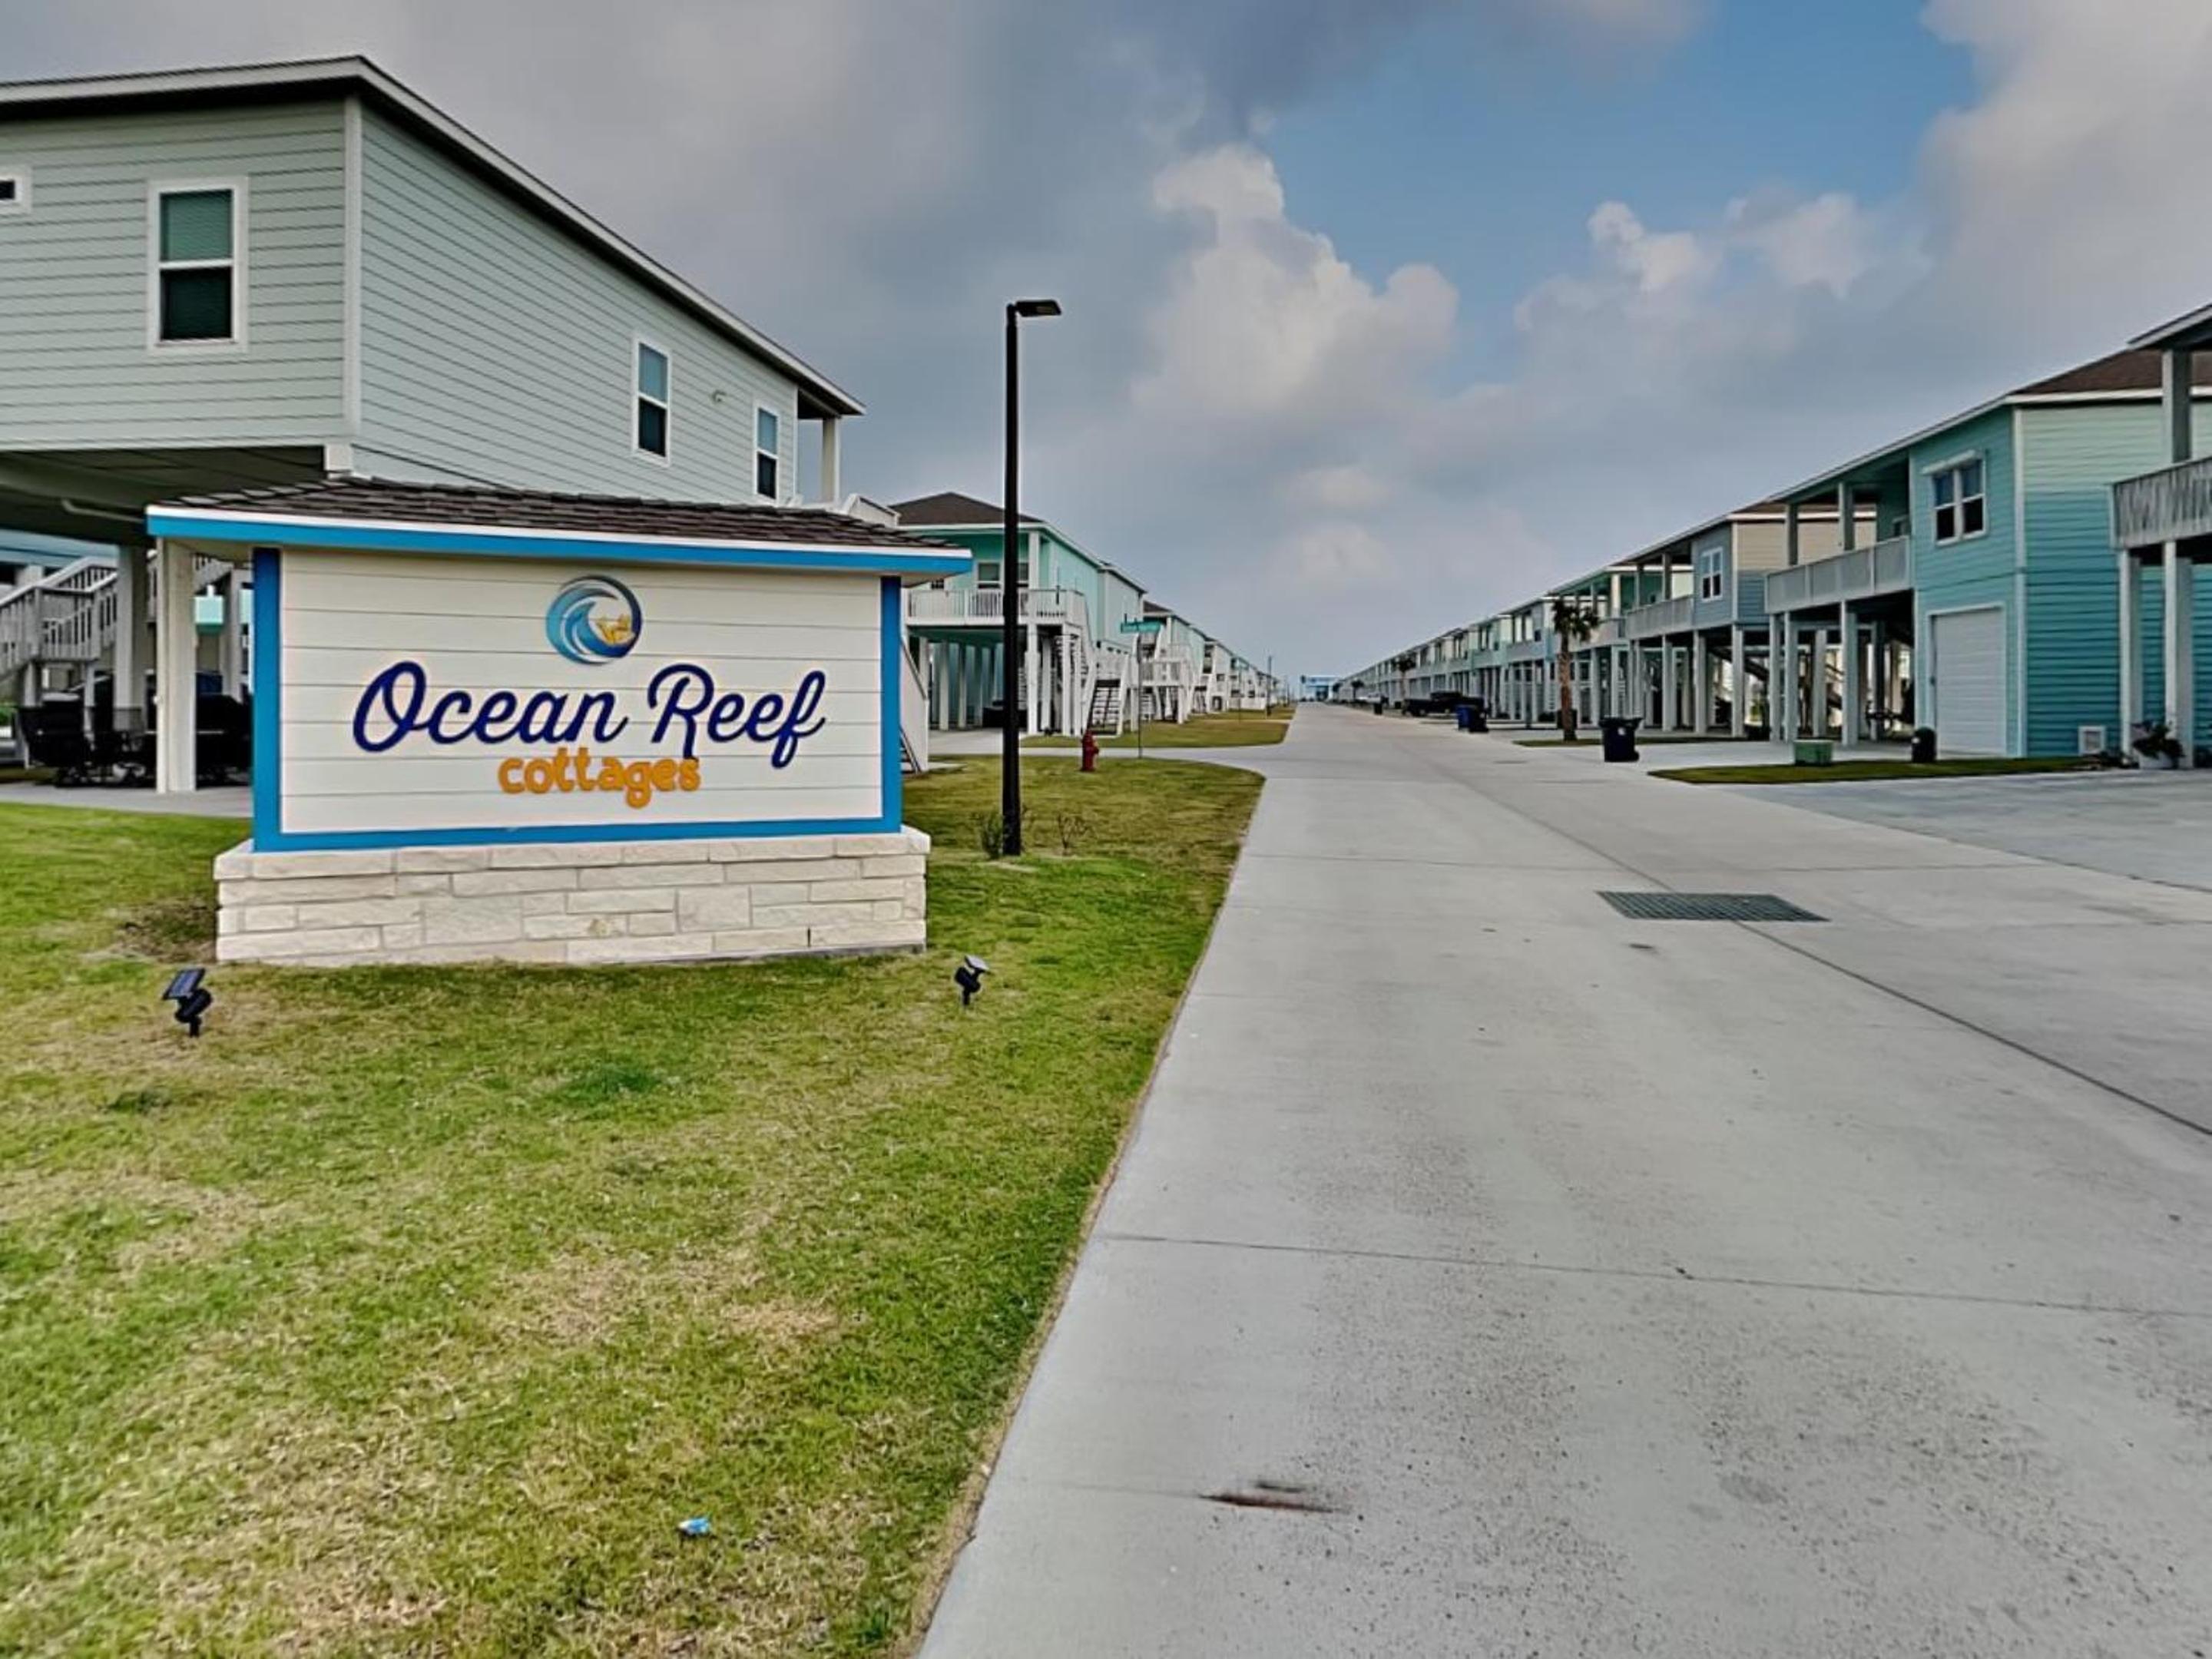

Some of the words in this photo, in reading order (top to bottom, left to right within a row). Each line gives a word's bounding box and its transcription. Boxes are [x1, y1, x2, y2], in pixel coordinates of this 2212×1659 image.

[353, 661, 628, 753] Ocean
[647, 664, 827, 770] Reef
[498, 747, 701, 809] cottages
